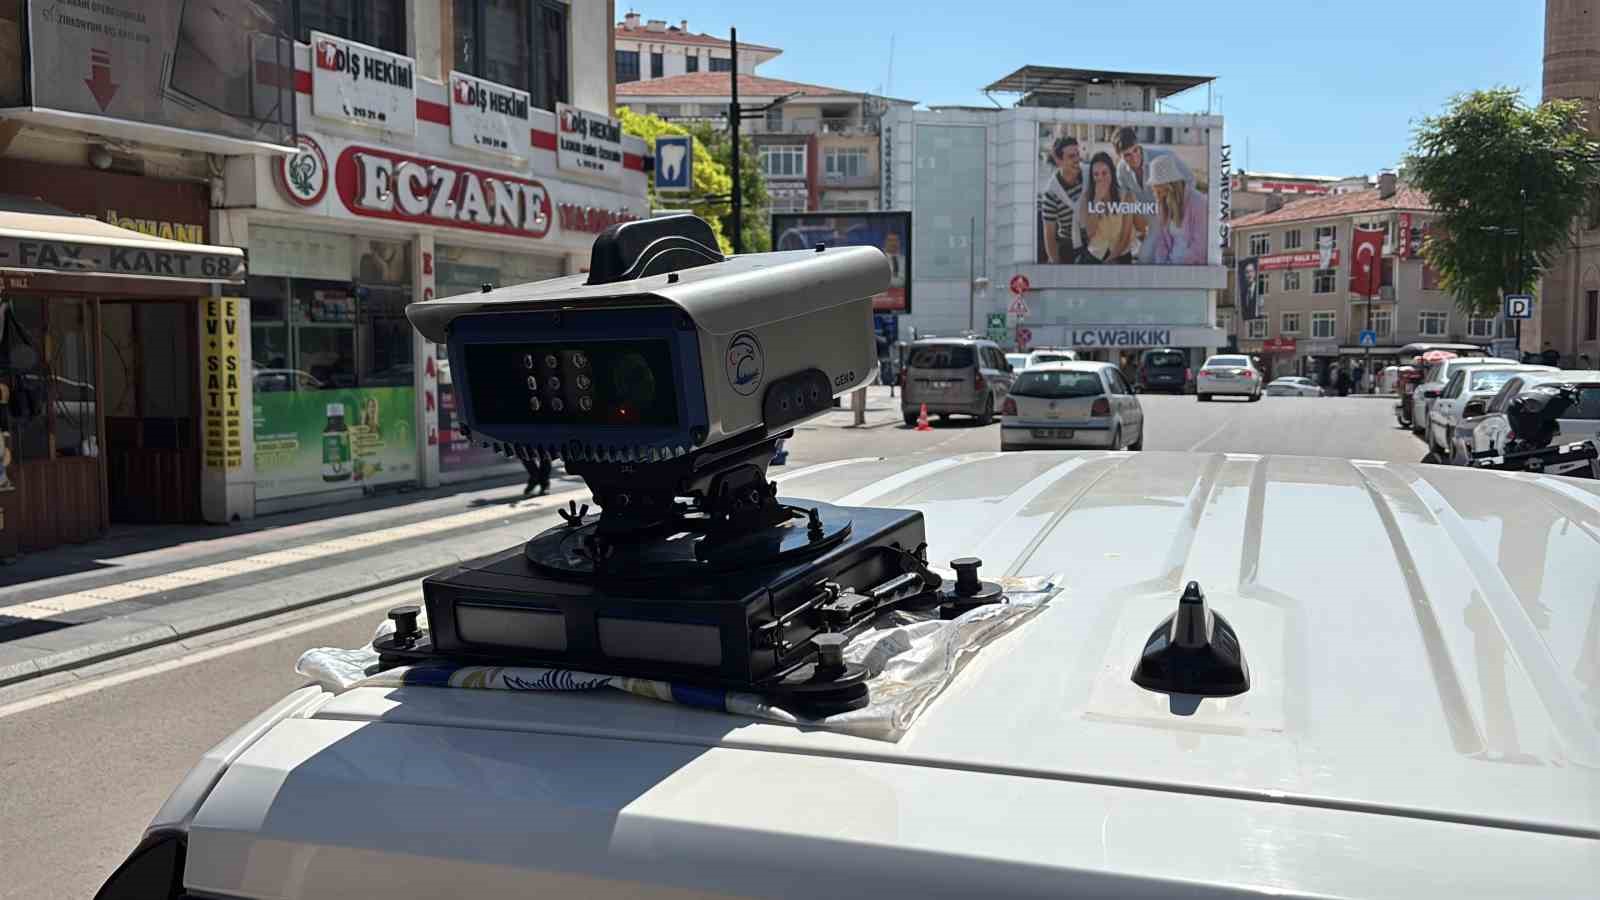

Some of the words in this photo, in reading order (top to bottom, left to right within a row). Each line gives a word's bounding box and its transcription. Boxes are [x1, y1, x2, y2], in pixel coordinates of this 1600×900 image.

[336, 46, 361, 82] DİŞ
[364, 56, 413, 90] HEKİMİ
[467, 81, 487, 113] DİŞ
[489, 91, 529, 120] HEKİMİ
[572, 112, 588, 140] DİŞ
[590, 119, 621, 144] HEKİMİ
[354, 152, 547, 231] ECZANE
[1088, 201, 1106, 214] LC
[18, 242, 82, 269] FAX
[108, 249, 191, 275] KART
[201, 256, 232, 276] 68
[1513, 301, 1525, 314] D
[422, 252, 438, 447] ECANE
[1072, 331, 1095, 346] LC
